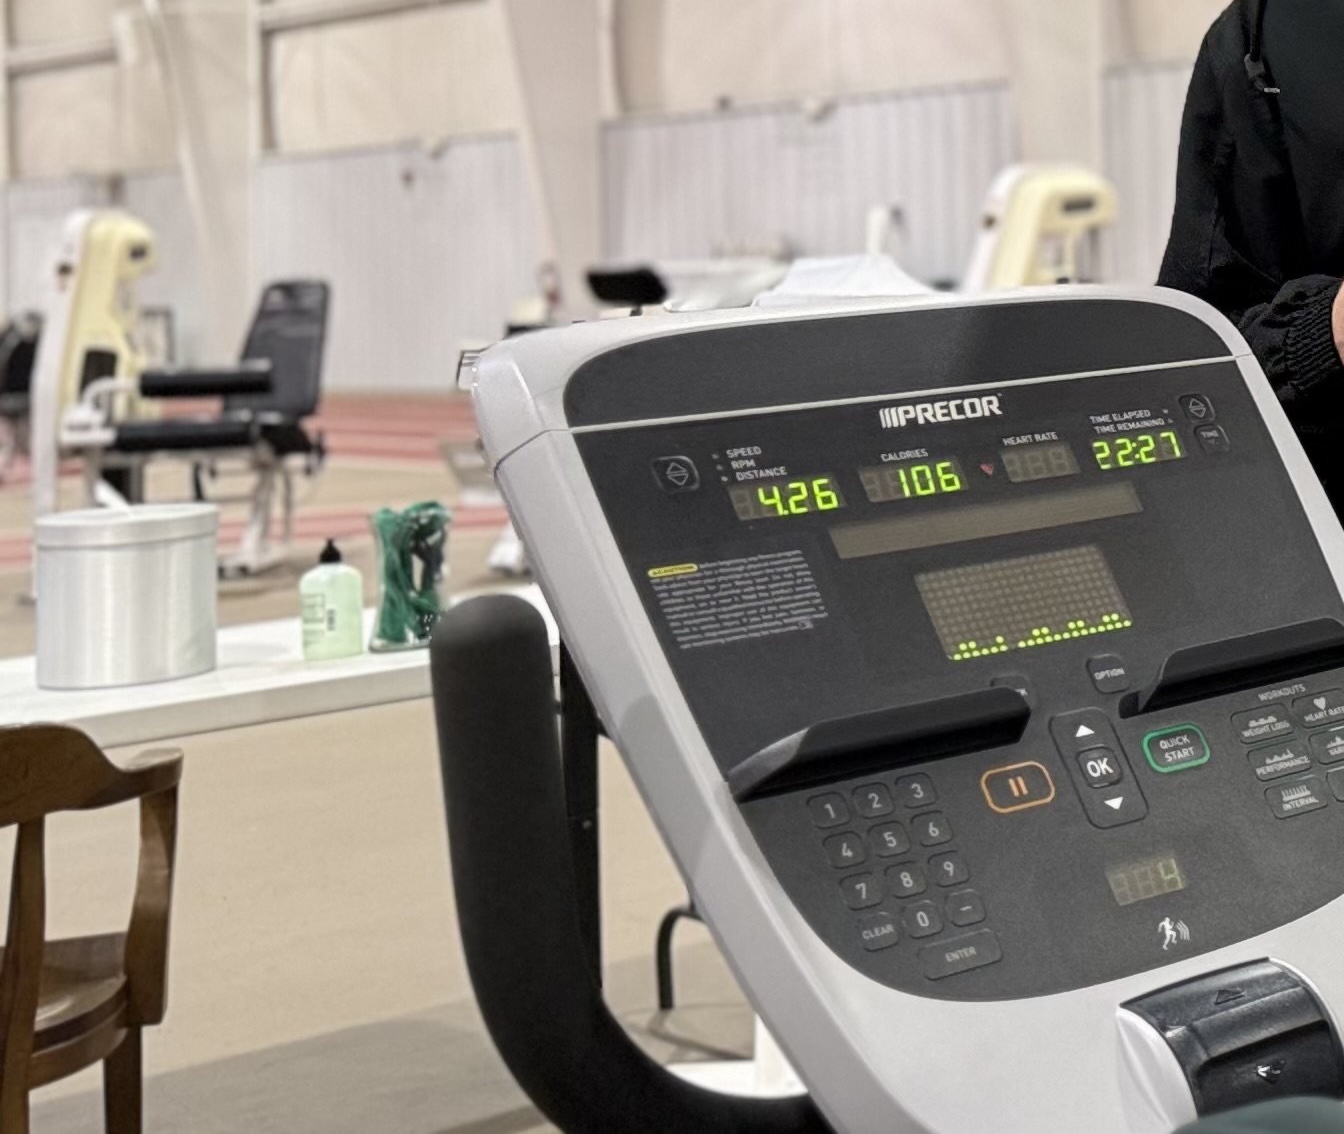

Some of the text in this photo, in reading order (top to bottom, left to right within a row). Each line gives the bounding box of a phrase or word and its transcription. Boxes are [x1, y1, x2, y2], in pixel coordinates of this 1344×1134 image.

[895, 394, 1004, 428] PRECOR
[1112, 409, 1152, 422] ELAPSED
[1034, 431, 1059, 442] RATE
[726, 445, 762, 459] SPEED
[880, 447, 929, 463] CALORIES
[1092, 431, 1182, 470] 22:27
[731, 458, 756, 470] RPM
[735, 466, 788, 482] DISTANCE
[897, 461, 962, 497] 106
[757, 478, 839, 516] 4.26
[1093, 666, 1126, 681] OPTION
[1257, 683, 1307, 702] WORKOUTS
[1159, 734, 1191, 750] QUICK
[1164, 747, 1196, 763] START
[1086, 757, 1115, 778] OK
[910, 782, 924, 799] 3
[868, 792, 883, 809] 2
[823, 803, 836, 819] 1
[927, 821, 940, 838] 6
[883, 831, 897, 848] 5
[841, 842, 854, 858] 4
[943, 860, 955, 877] 9
[900, 871, 914, 888] 8
[855, 883, 868, 900] 7
[915, 911, 930, 927] 0
[861, 923, 896, 941] CLEAR
[943, 945, 978, 963] ENTER
